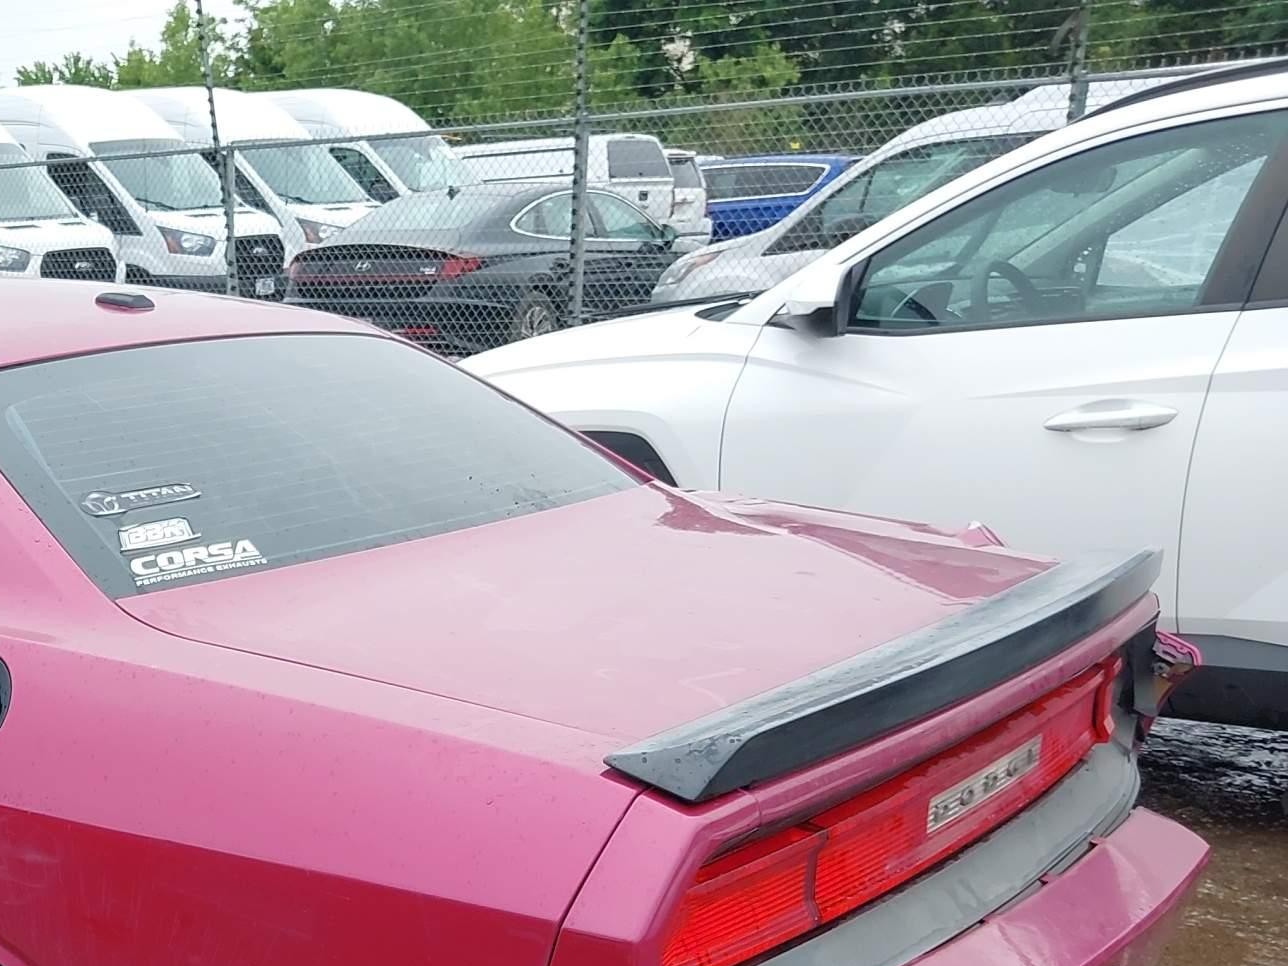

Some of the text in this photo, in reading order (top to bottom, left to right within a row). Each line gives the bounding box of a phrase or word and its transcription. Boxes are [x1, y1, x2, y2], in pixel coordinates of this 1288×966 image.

[121, 484, 194, 504] TITAN
[130, 539, 261, 576] CORSA
[136, 566, 215, 587] PERFORMANCE
